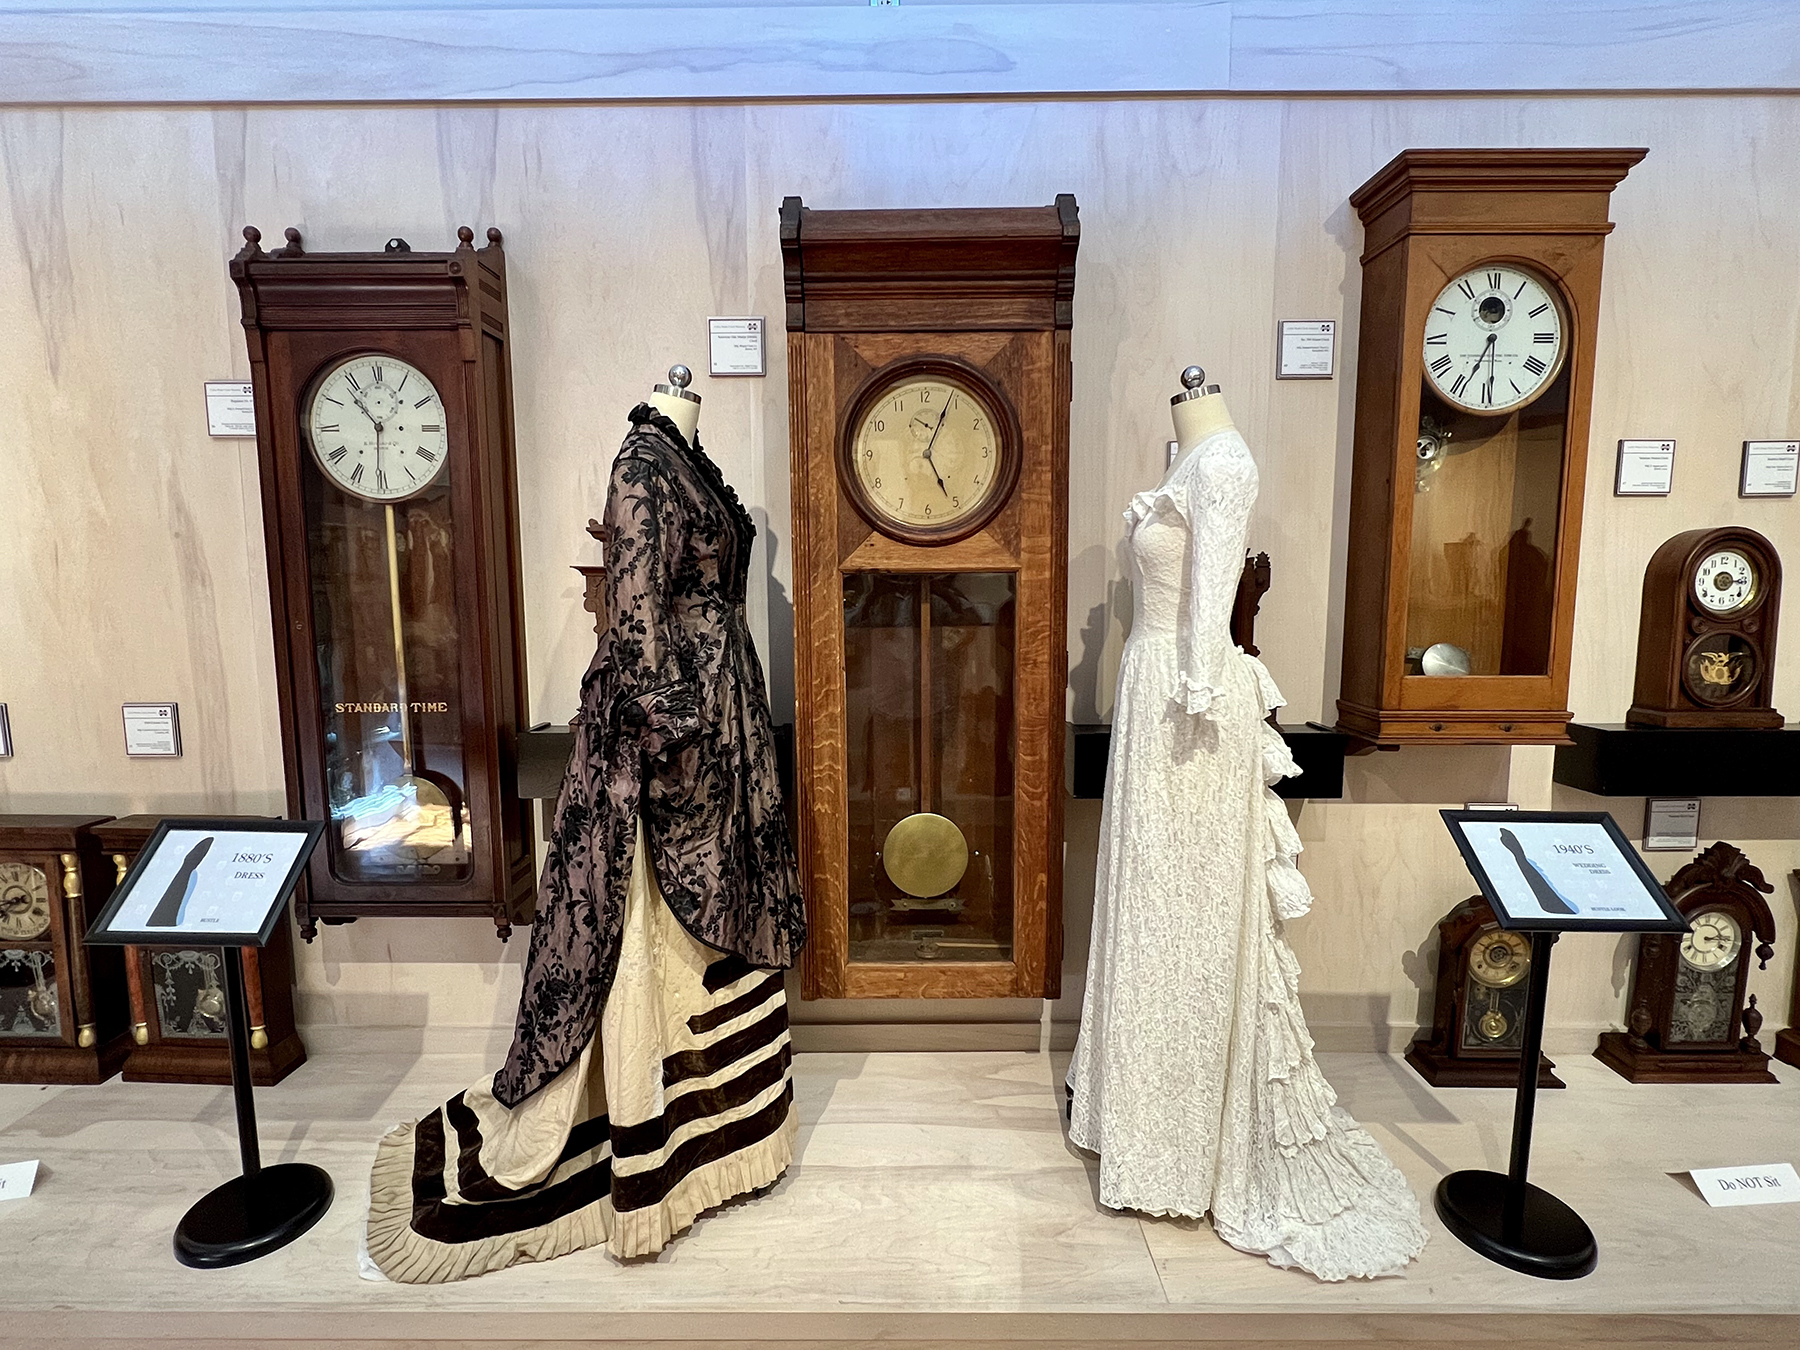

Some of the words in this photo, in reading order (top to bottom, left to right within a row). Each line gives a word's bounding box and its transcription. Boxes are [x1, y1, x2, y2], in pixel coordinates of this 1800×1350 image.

[1528, 303, 1548, 318] II
[1534, 333, 1554, 343] III
[920, 391, 930, 403] 12
[894, 401, 903, 411] 11
[421, 424, 440, 433] III
[874, 421, 885, 432] 10
[973, 419, 980, 431] 2
[866, 450, 873, 461] 9
[982, 447, 988, 458] 3
[874, 478, 882, 489] 8
[973, 475, 980, 485] 4
[898, 498, 905, 509] 7
[953, 497, 960, 508] 5
[925, 504, 932, 515] 6
[1721, 557, 1728, 565] 12
[1703, 568, 1710, 576] 10
[410, 702, 448, 713] TIME
[1553, 844, 1594, 855] 1940'S
[232, 853, 273, 864] 1880'S
[234, 871, 265, 880] DRESS
[1717, 1179, 1736, 1191] Do
[1735, 1177, 1763, 1190] NOT
[1763, 1176, 1782, 1188] Sit
